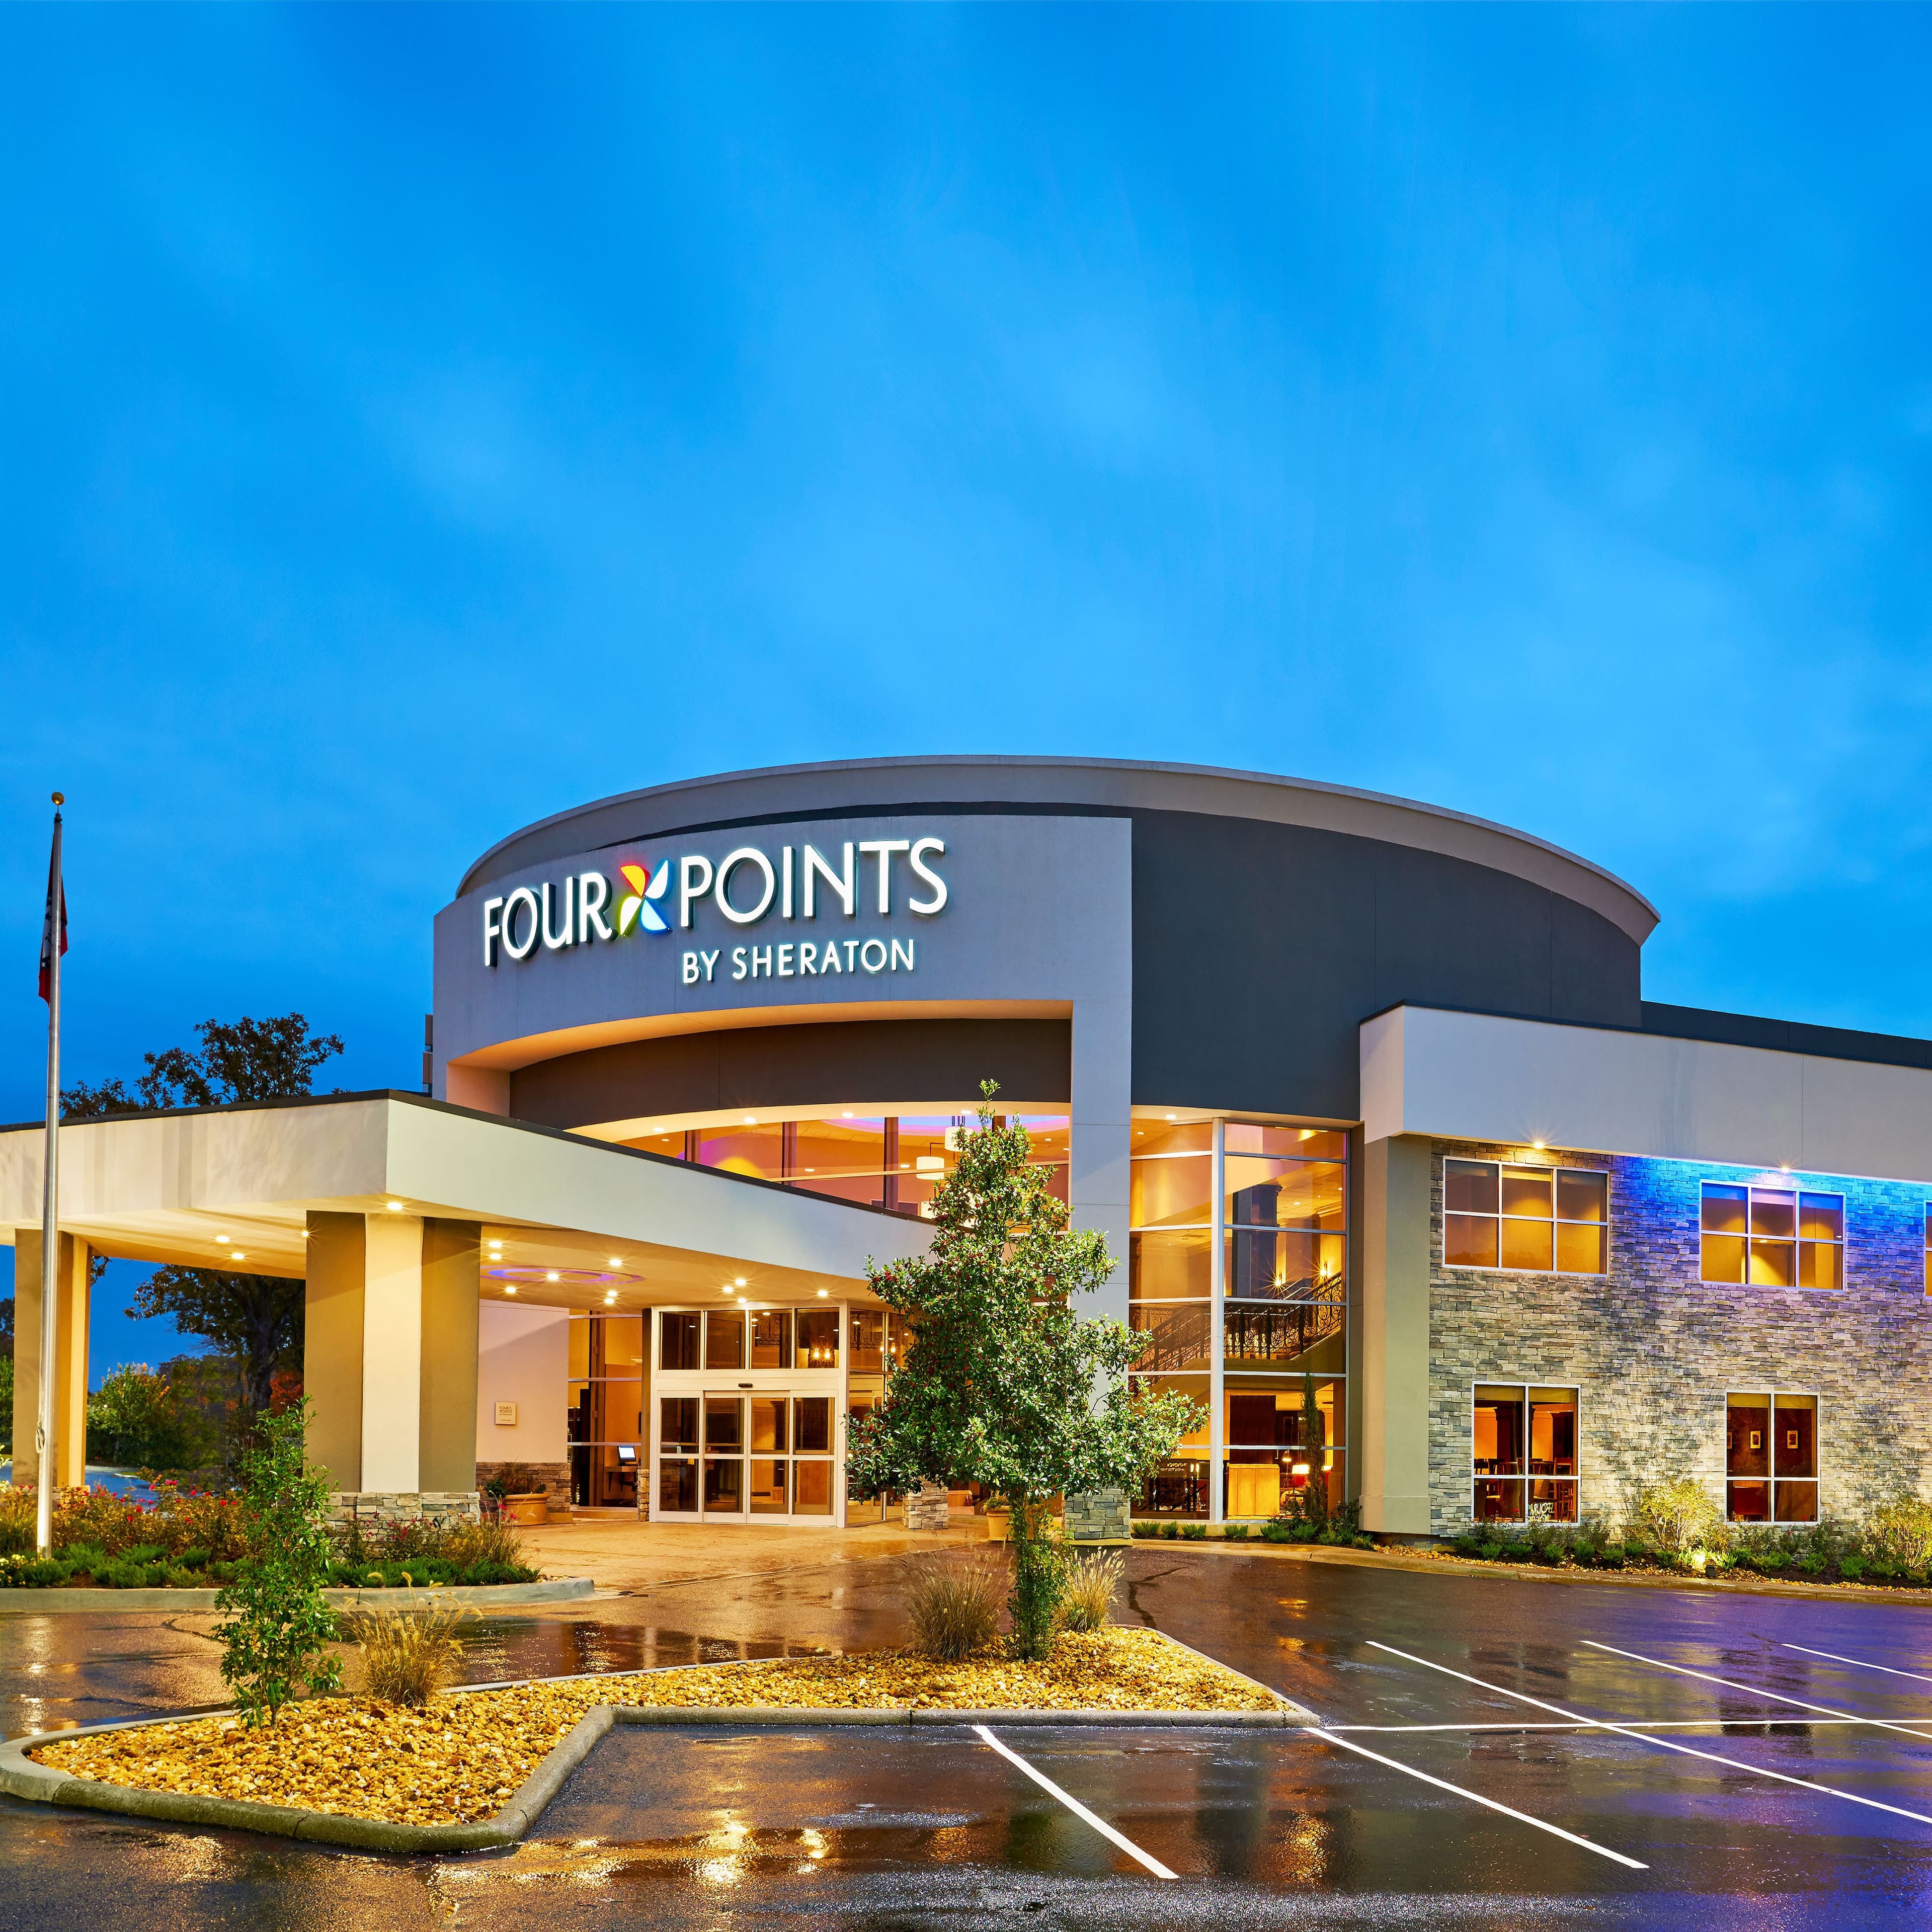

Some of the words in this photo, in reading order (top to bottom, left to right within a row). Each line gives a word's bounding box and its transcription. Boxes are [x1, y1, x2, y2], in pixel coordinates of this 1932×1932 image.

[484, 872, 614, 967] FOUR
[681, 837, 948, 928] POINTS
[682, 949, 721, 984] BY
[732, 938, 915, 980] SHERATON
